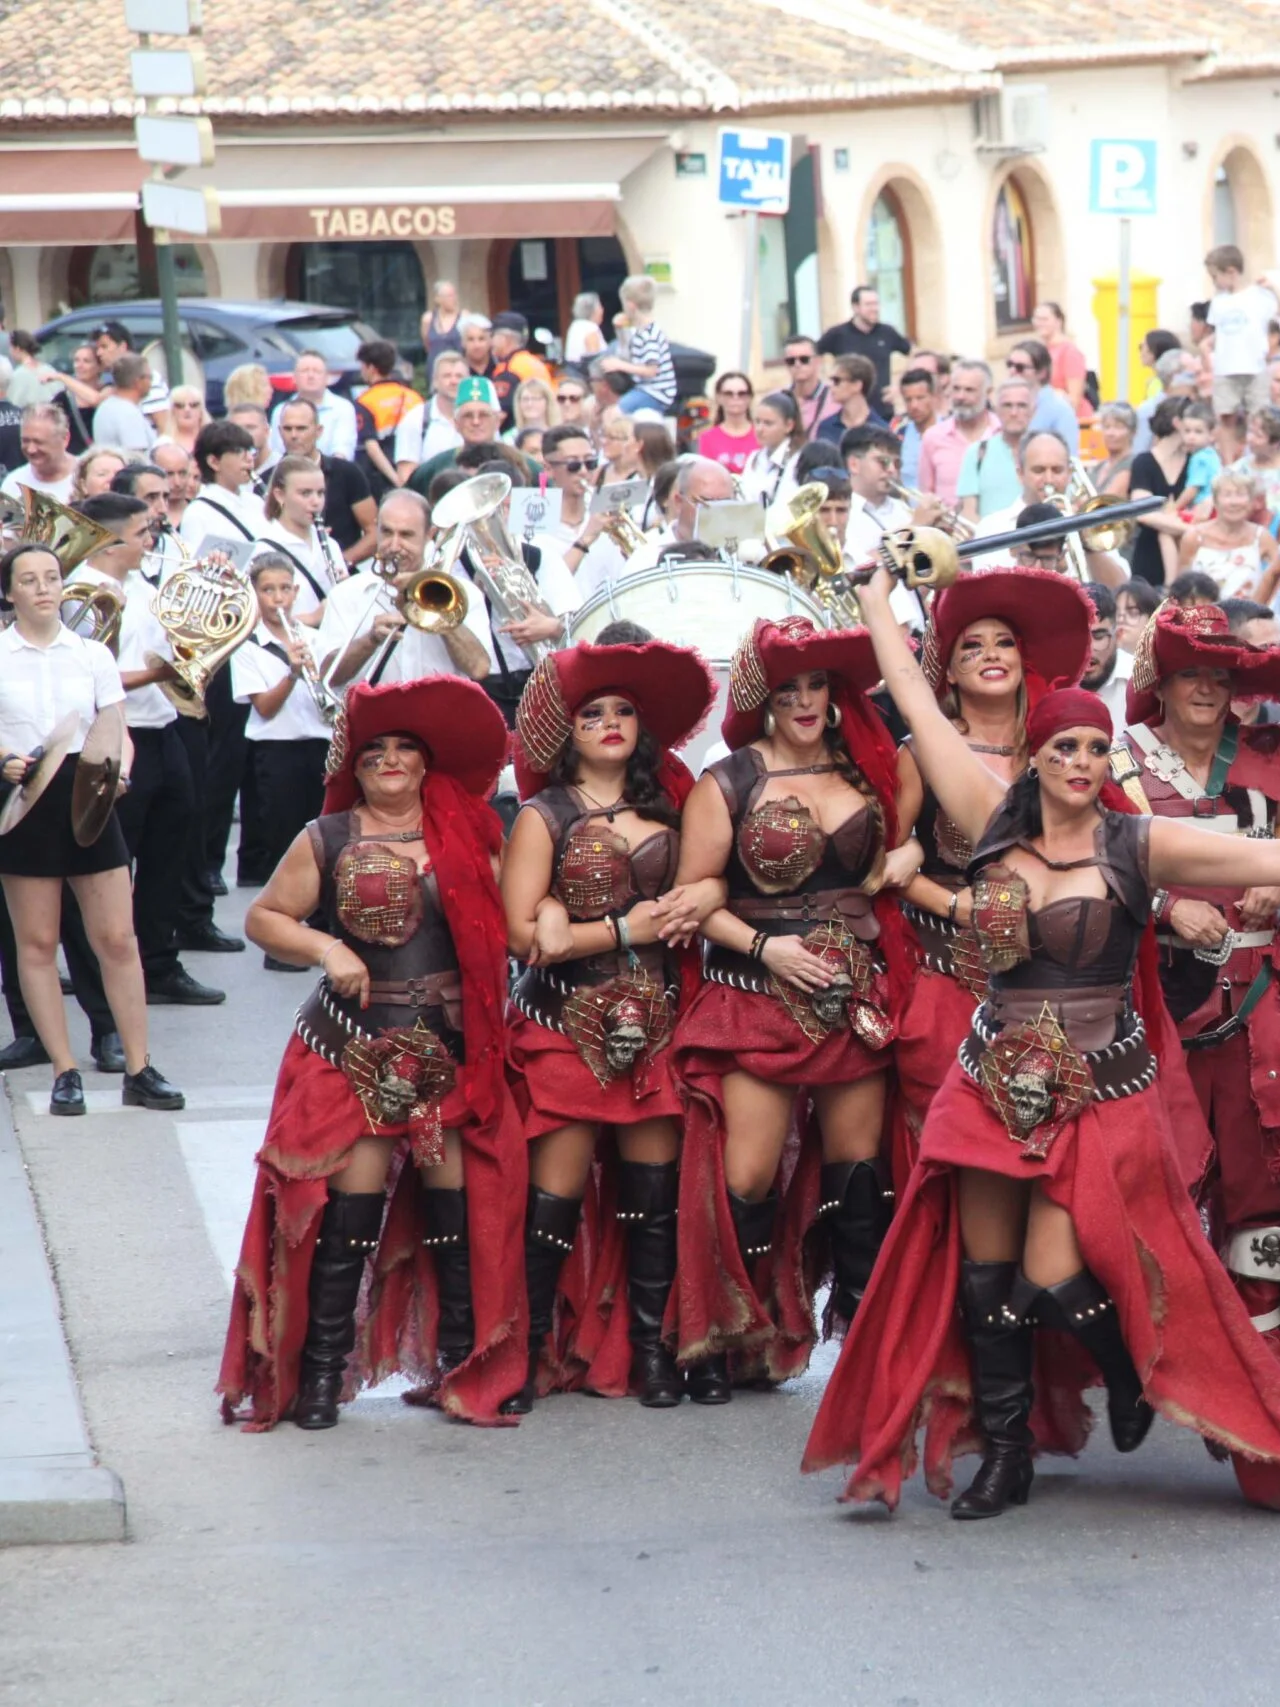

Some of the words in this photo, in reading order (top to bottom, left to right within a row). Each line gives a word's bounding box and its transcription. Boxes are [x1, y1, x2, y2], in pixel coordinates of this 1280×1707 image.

[722, 157, 782, 180] TAXI
[1101, 144, 1146, 208] P
[309, 206, 456, 237] TABACOS
